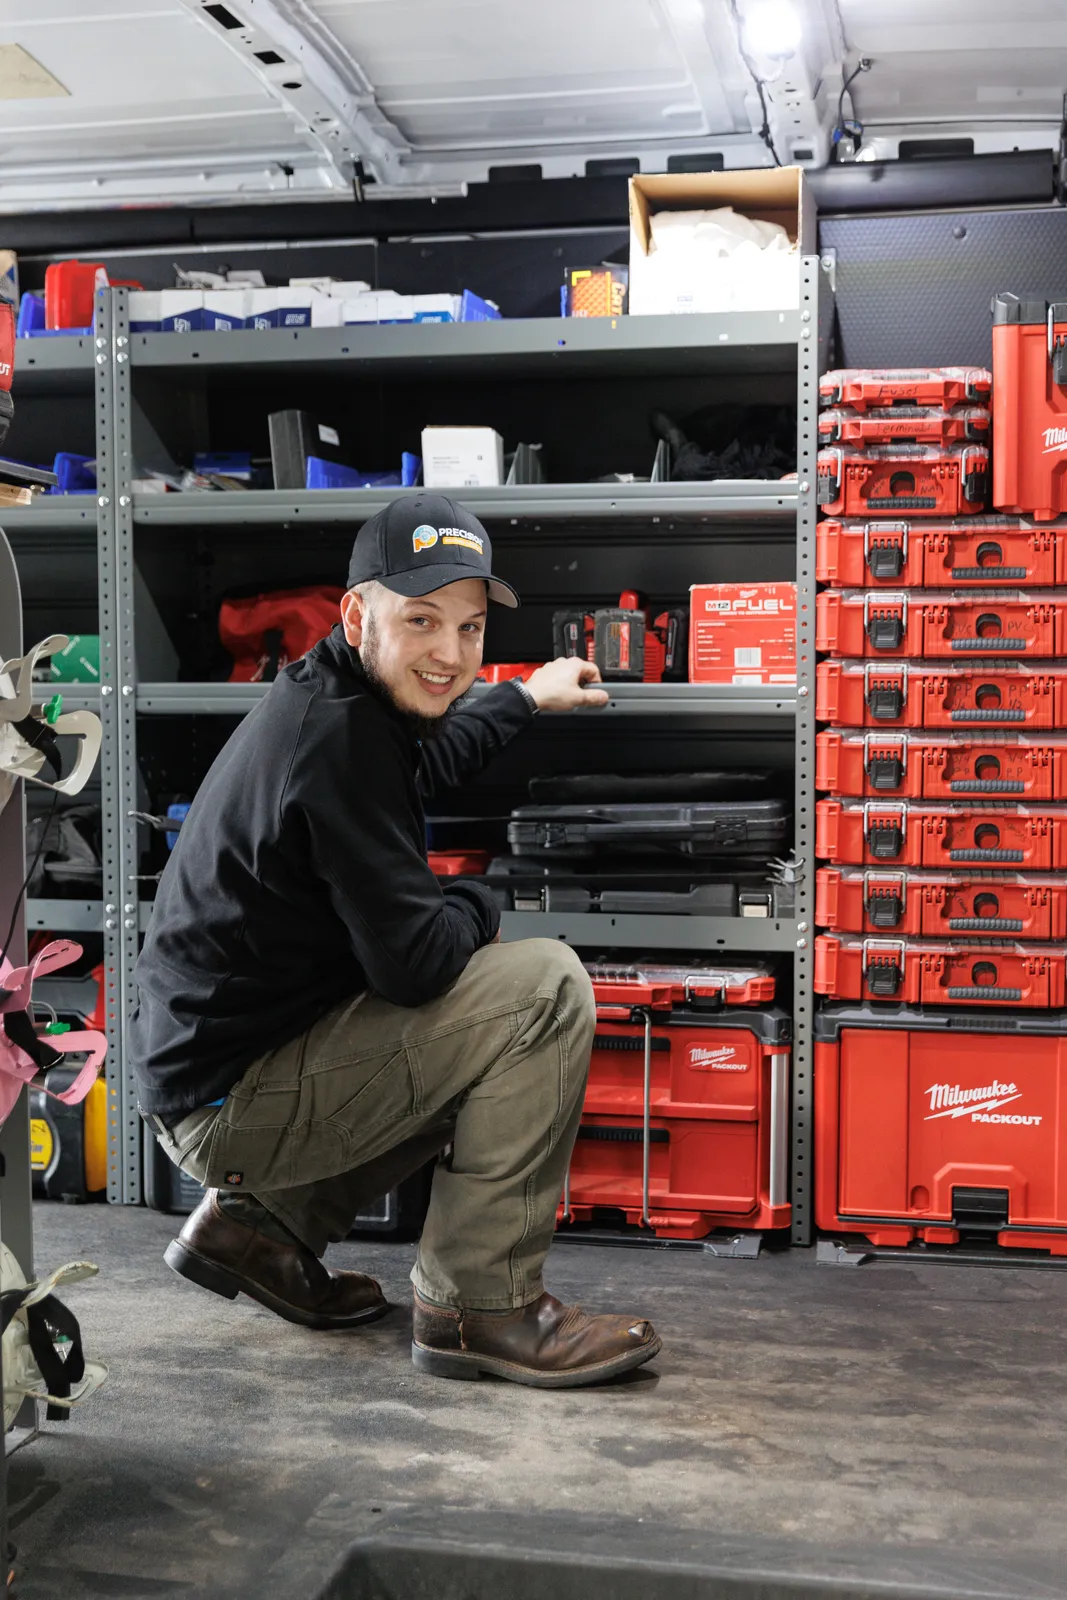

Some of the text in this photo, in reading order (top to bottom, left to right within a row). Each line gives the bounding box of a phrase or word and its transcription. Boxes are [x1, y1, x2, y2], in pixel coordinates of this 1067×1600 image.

[732, 599, 793, 611] FUEL
[924, 1080, 1018, 1111] Milwaukee
[971, 1113, 1042, 1125] PACKOUT
